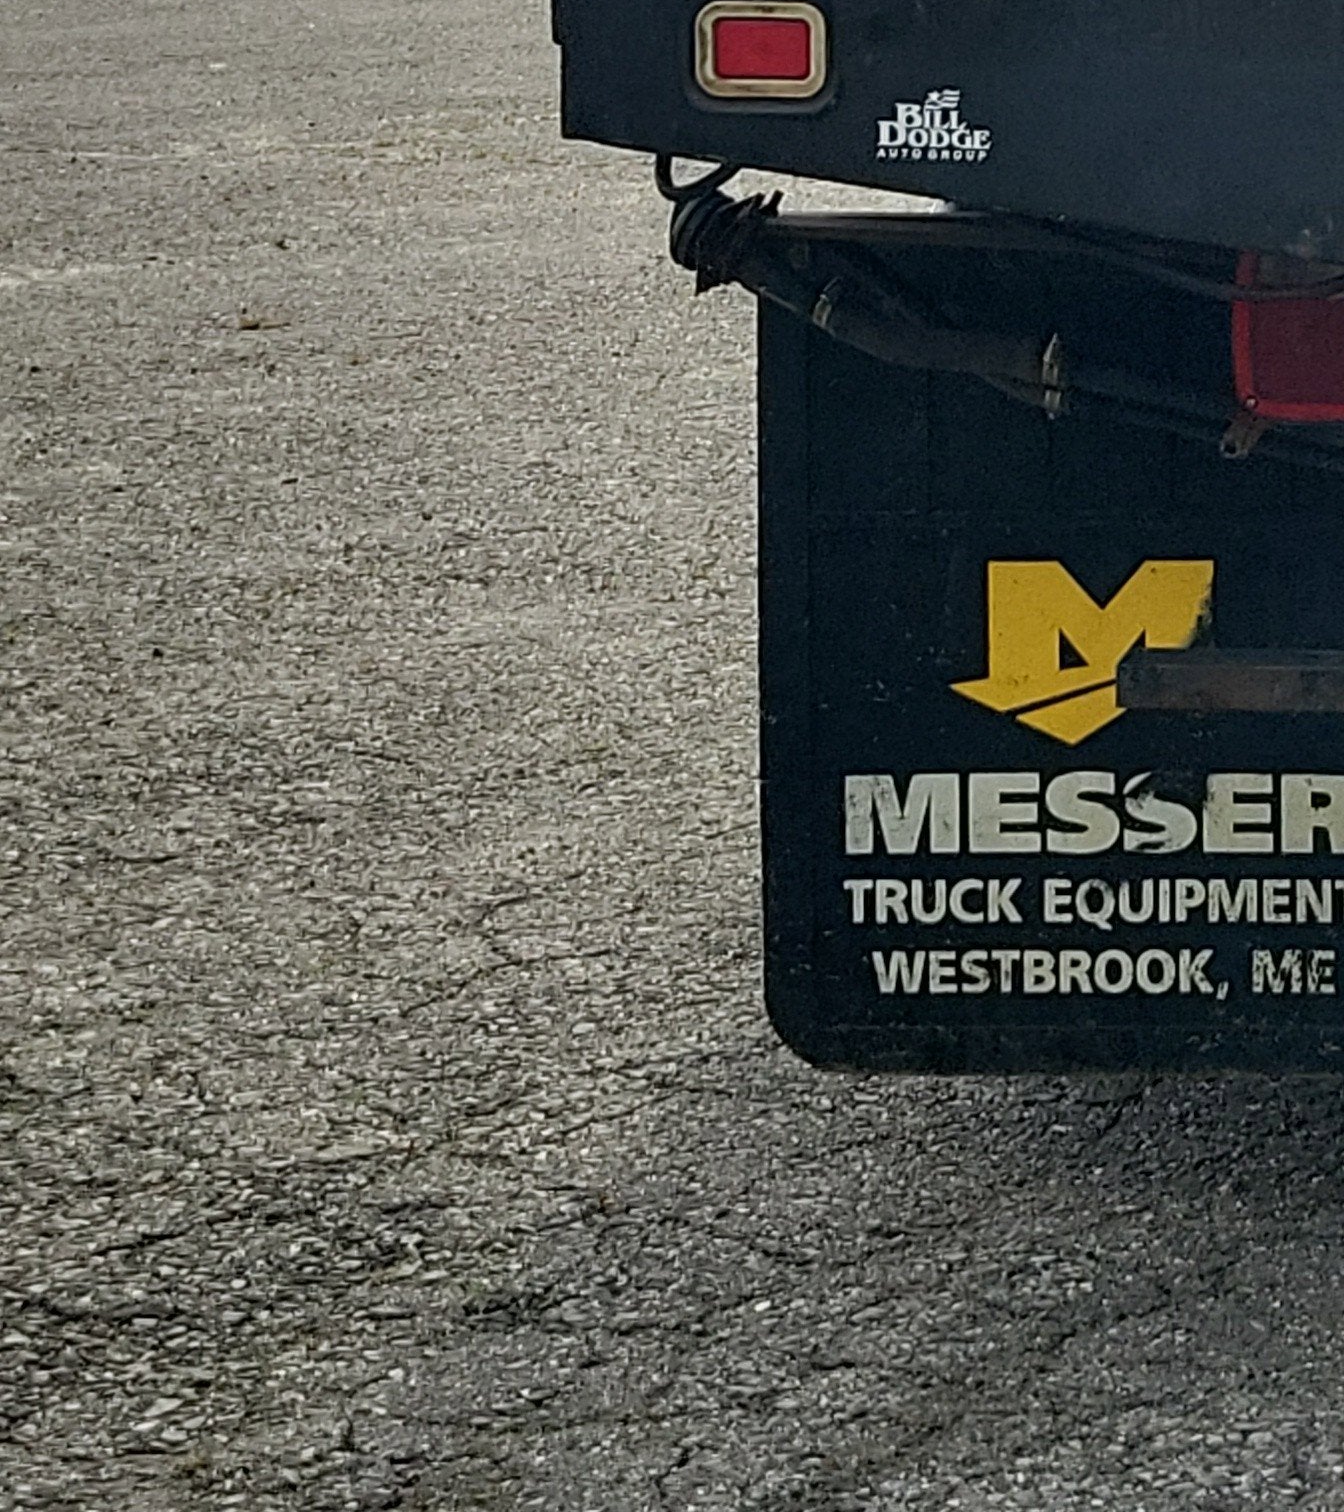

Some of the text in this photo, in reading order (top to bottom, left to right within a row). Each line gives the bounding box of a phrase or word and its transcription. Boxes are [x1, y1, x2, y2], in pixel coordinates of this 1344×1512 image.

[894, 102, 968, 130] BILL
[877, 120, 993, 150] DODGE
[876, 148, 988, 163] AUTO GROUP
[843, 878, 1023, 925] TRUCK
[872, 948, 1337, 1001] WESTBROOK, ME
